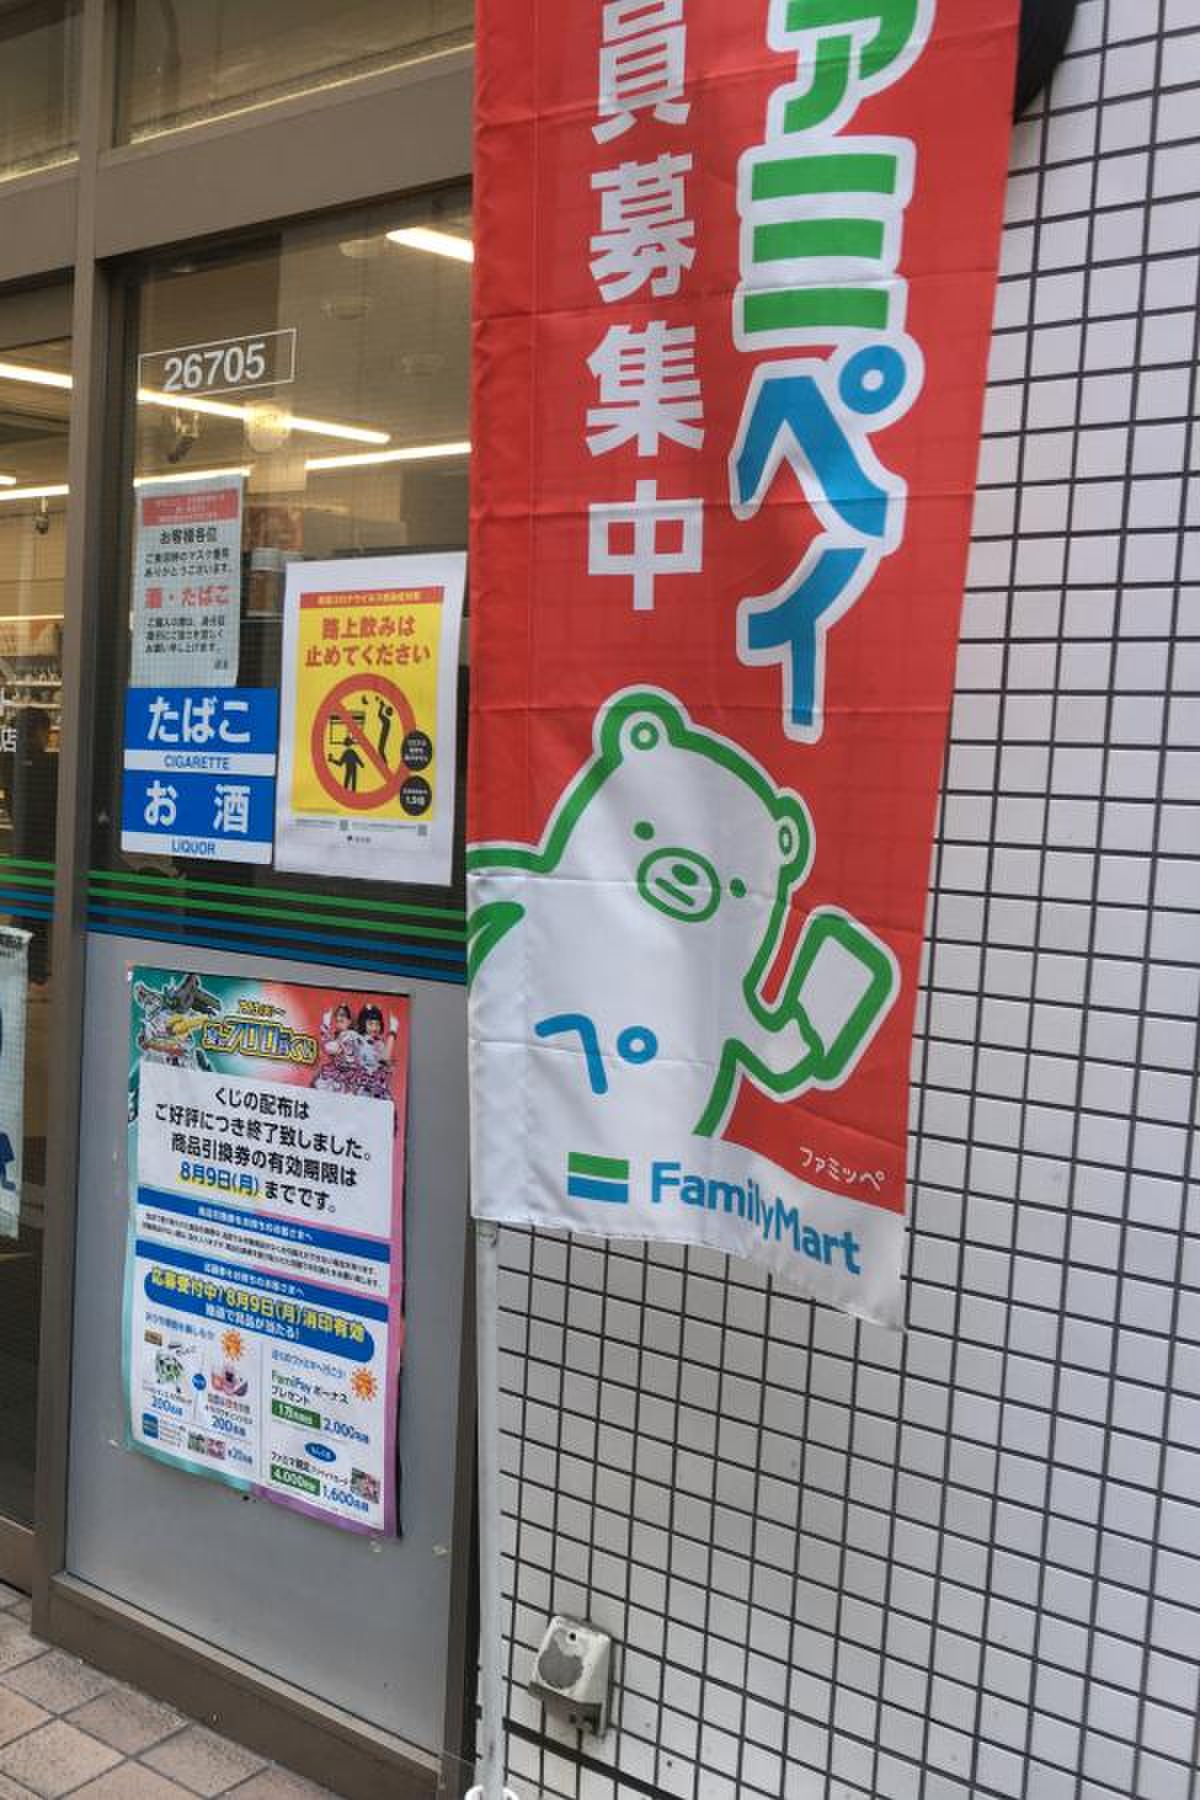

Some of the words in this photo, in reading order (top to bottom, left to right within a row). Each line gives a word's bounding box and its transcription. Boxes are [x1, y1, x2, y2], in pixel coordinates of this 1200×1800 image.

[163, 343, 266, 392] 26705
[321, 614, 416, 640] 路上飲みは
[305, 643, 431, 668] 止めてください
[146, 695, 251, 744] たばこ
[163, 754, 230, 770] CIGARETTE
[171, 838, 216, 855] LIQUOR
[214, 1087, 311, 1120] くじの配布は
[155, 1103, 372, 1161] ご好評につき終了致しました。
[171, 1132, 358, 1186] 商品引換券の有効期限は
[799, 1146, 886, 1191] ファミッペ
[650, 1161, 862, 1276] FamilyMart
